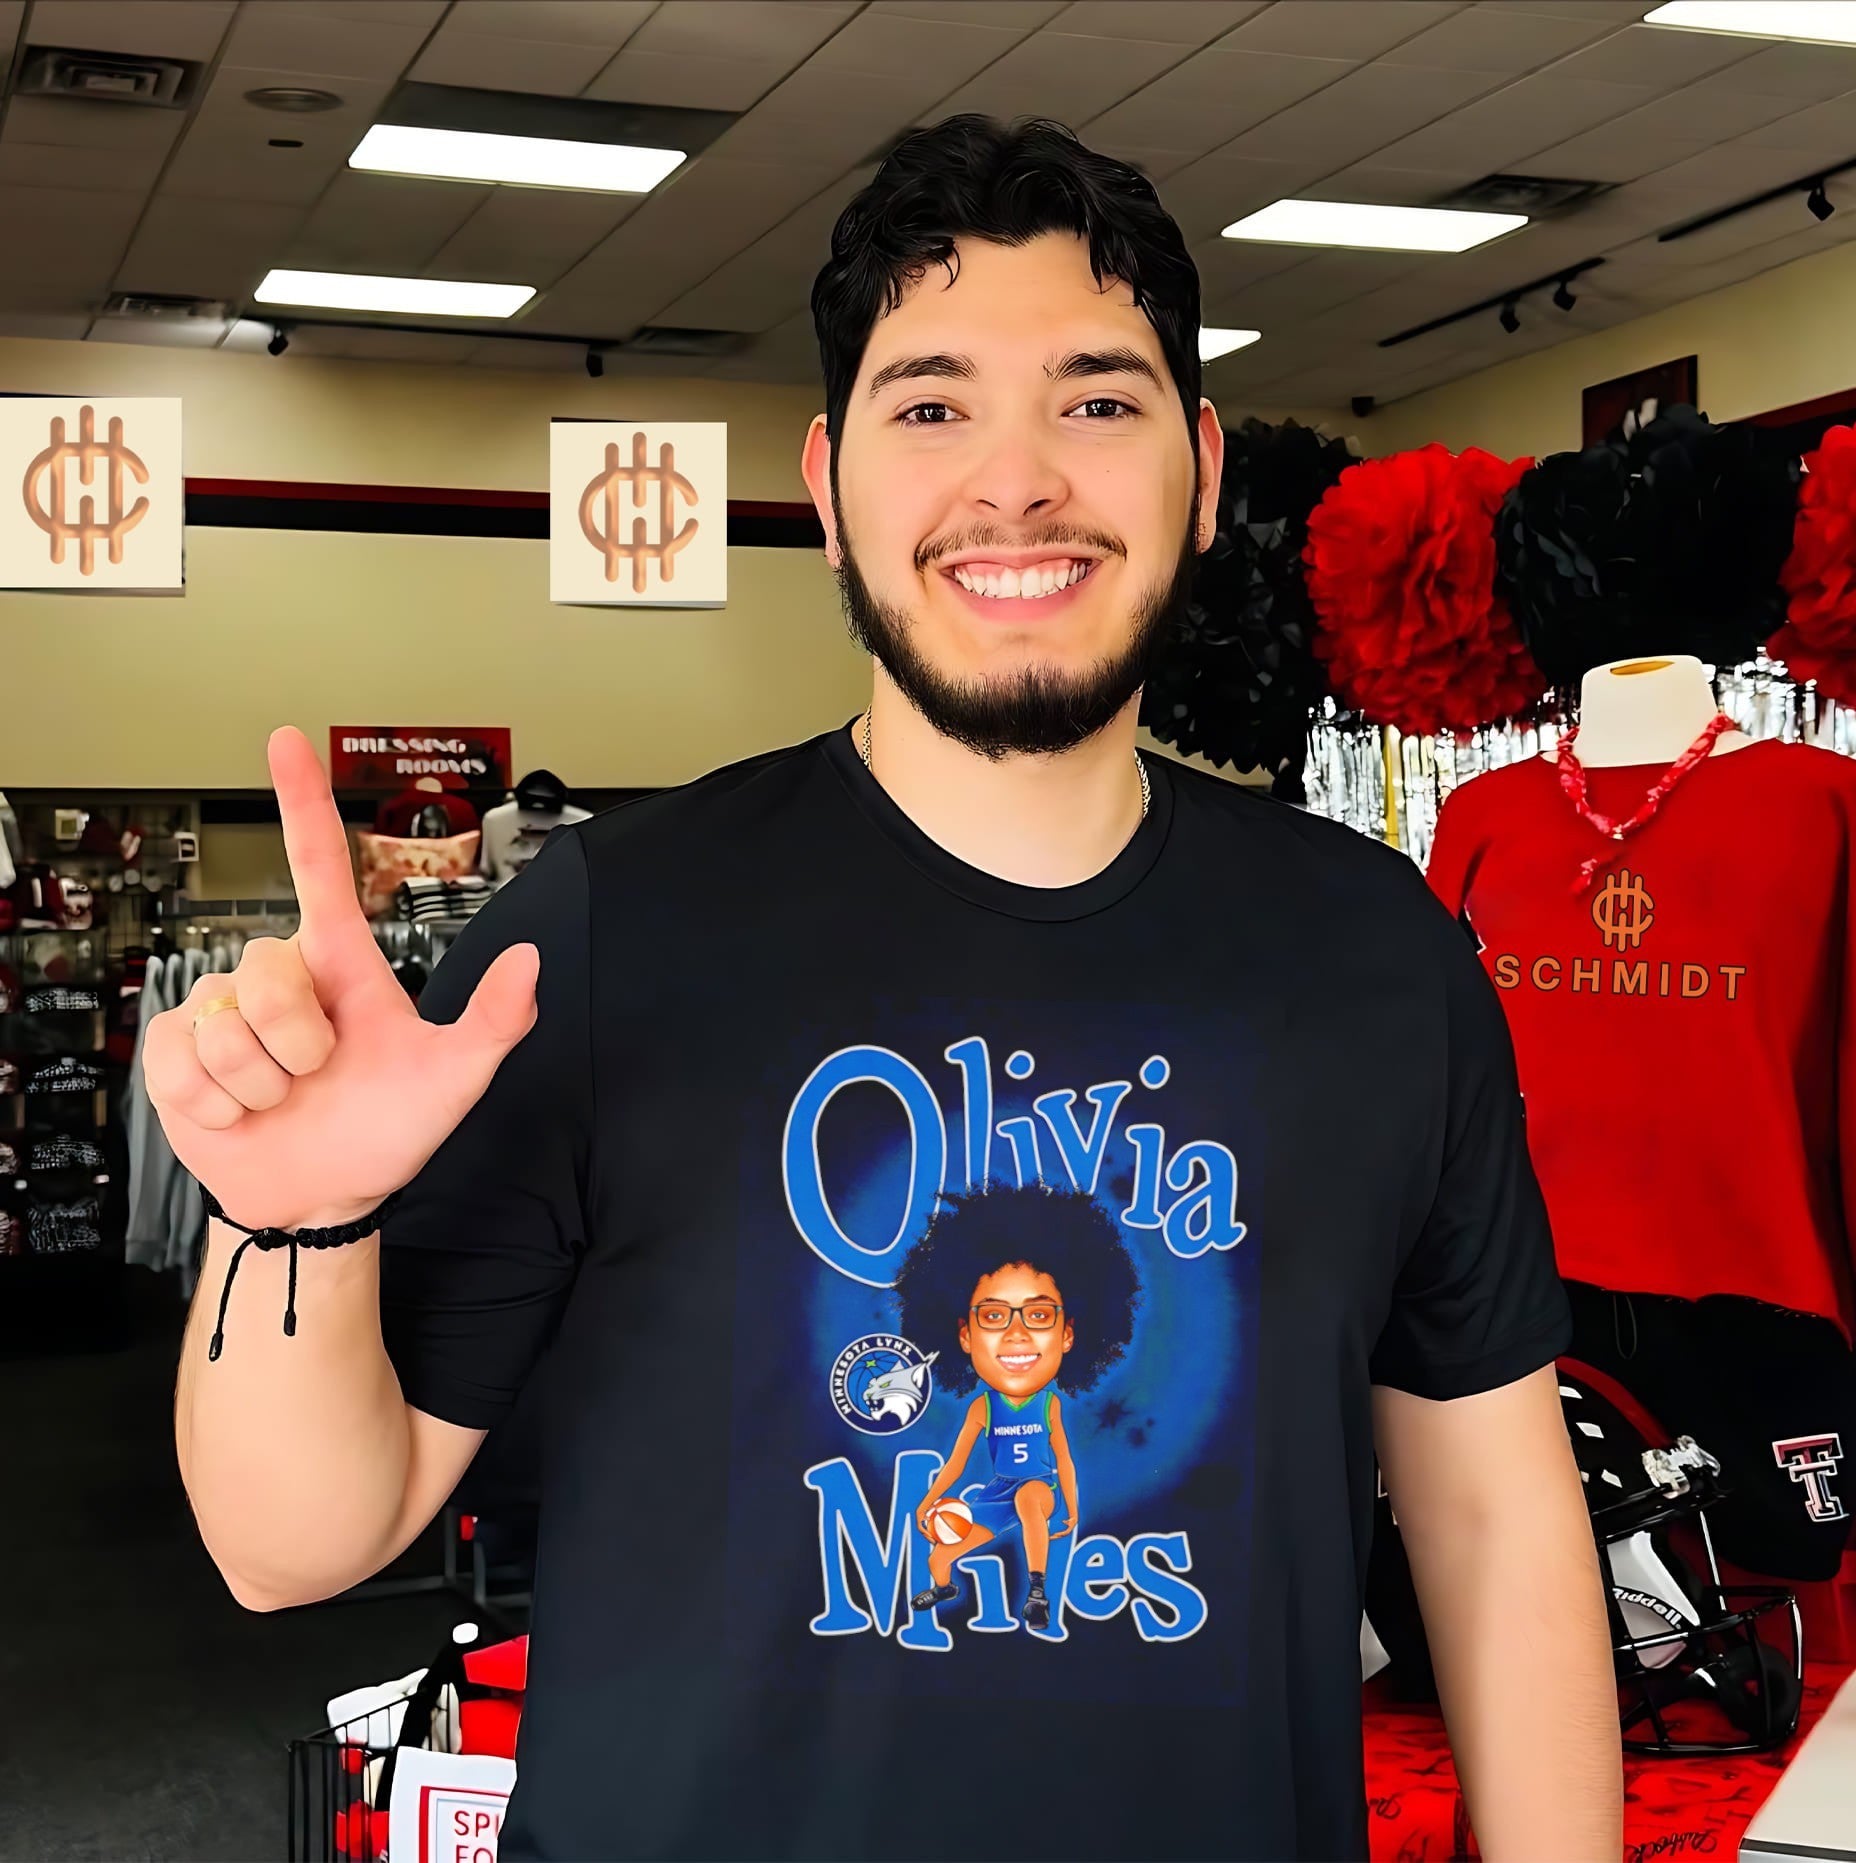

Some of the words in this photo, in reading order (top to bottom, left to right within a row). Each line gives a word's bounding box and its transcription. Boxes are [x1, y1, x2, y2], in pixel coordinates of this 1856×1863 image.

[342, 737, 467, 754] DRESSING
[396, 758, 487, 775] ROOMS
[1494, 953, 1747, 1000] SCHMIDT
[782, 1036, 1248, 1289] Olivia
[834, 1341, 870, 1415] MINNESOTA
[876, 1337, 912, 1356] LYNX
[993, 1423, 1044, 1436] MINNESOTA
[1013, 1443, 1029, 1464] 5
